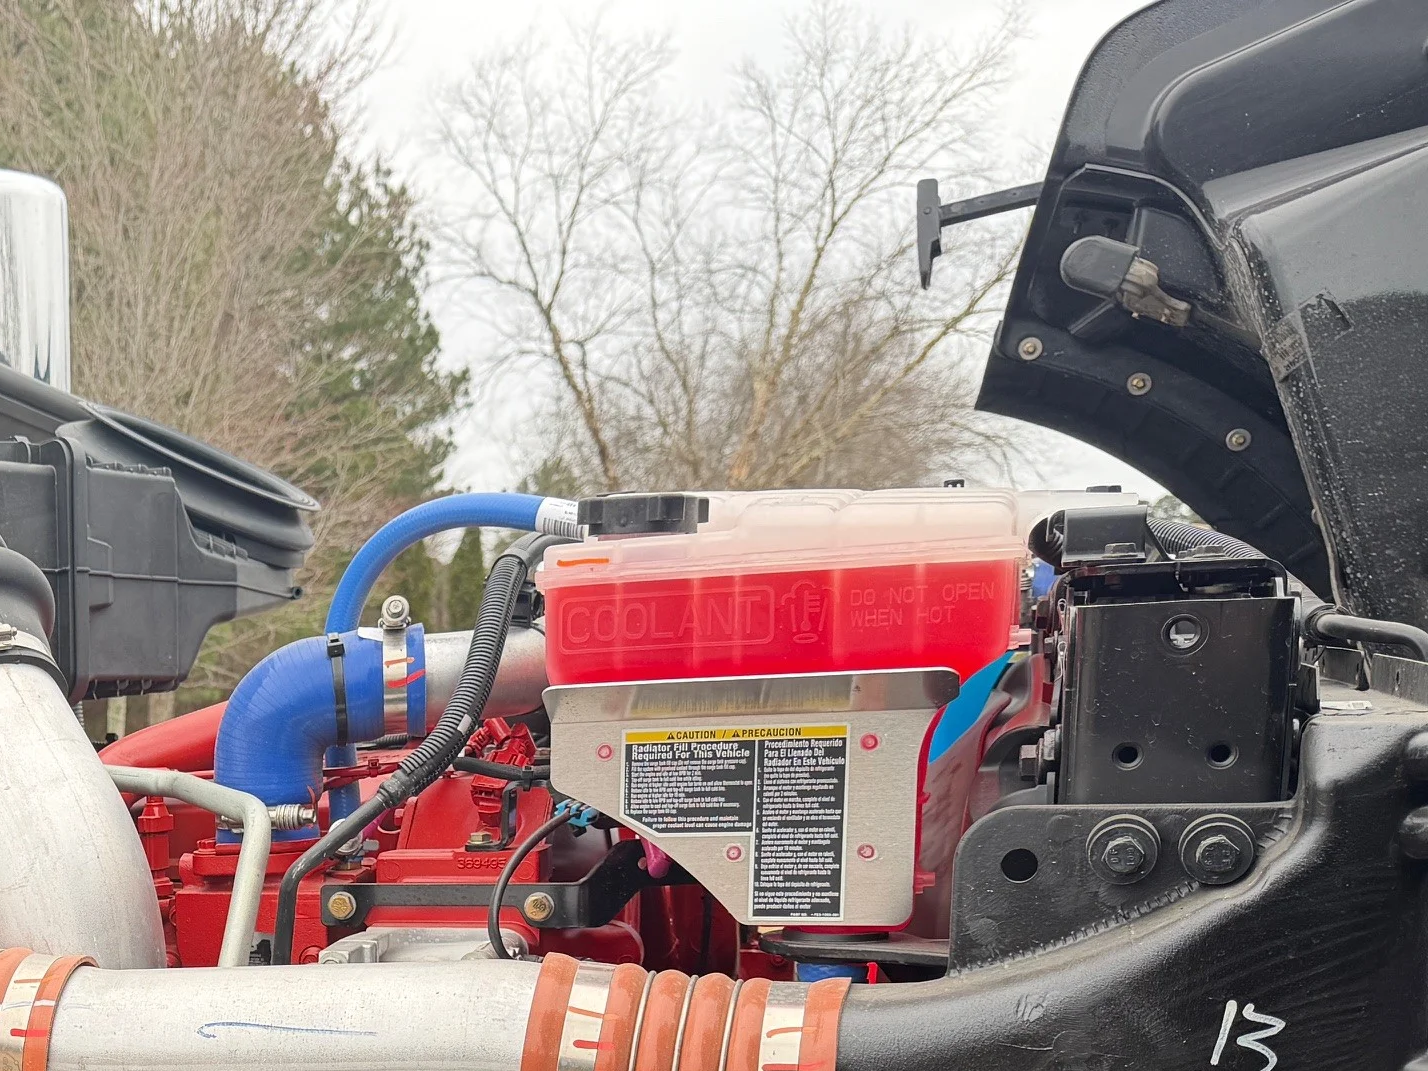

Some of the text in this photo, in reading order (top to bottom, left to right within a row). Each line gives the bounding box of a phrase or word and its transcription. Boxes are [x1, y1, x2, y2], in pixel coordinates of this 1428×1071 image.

[849, 582, 995, 606] DO NOT OPEN
[565, 595, 761, 644] COOLANT
[849, 606, 955, 628] WHEN HOT
[676, 730, 716, 740] CAUTION
[742, 728, 802, 738] PRECAUCION
[810, 739, 842, 747] Requerido
[632, 751, 672, 760] Required
